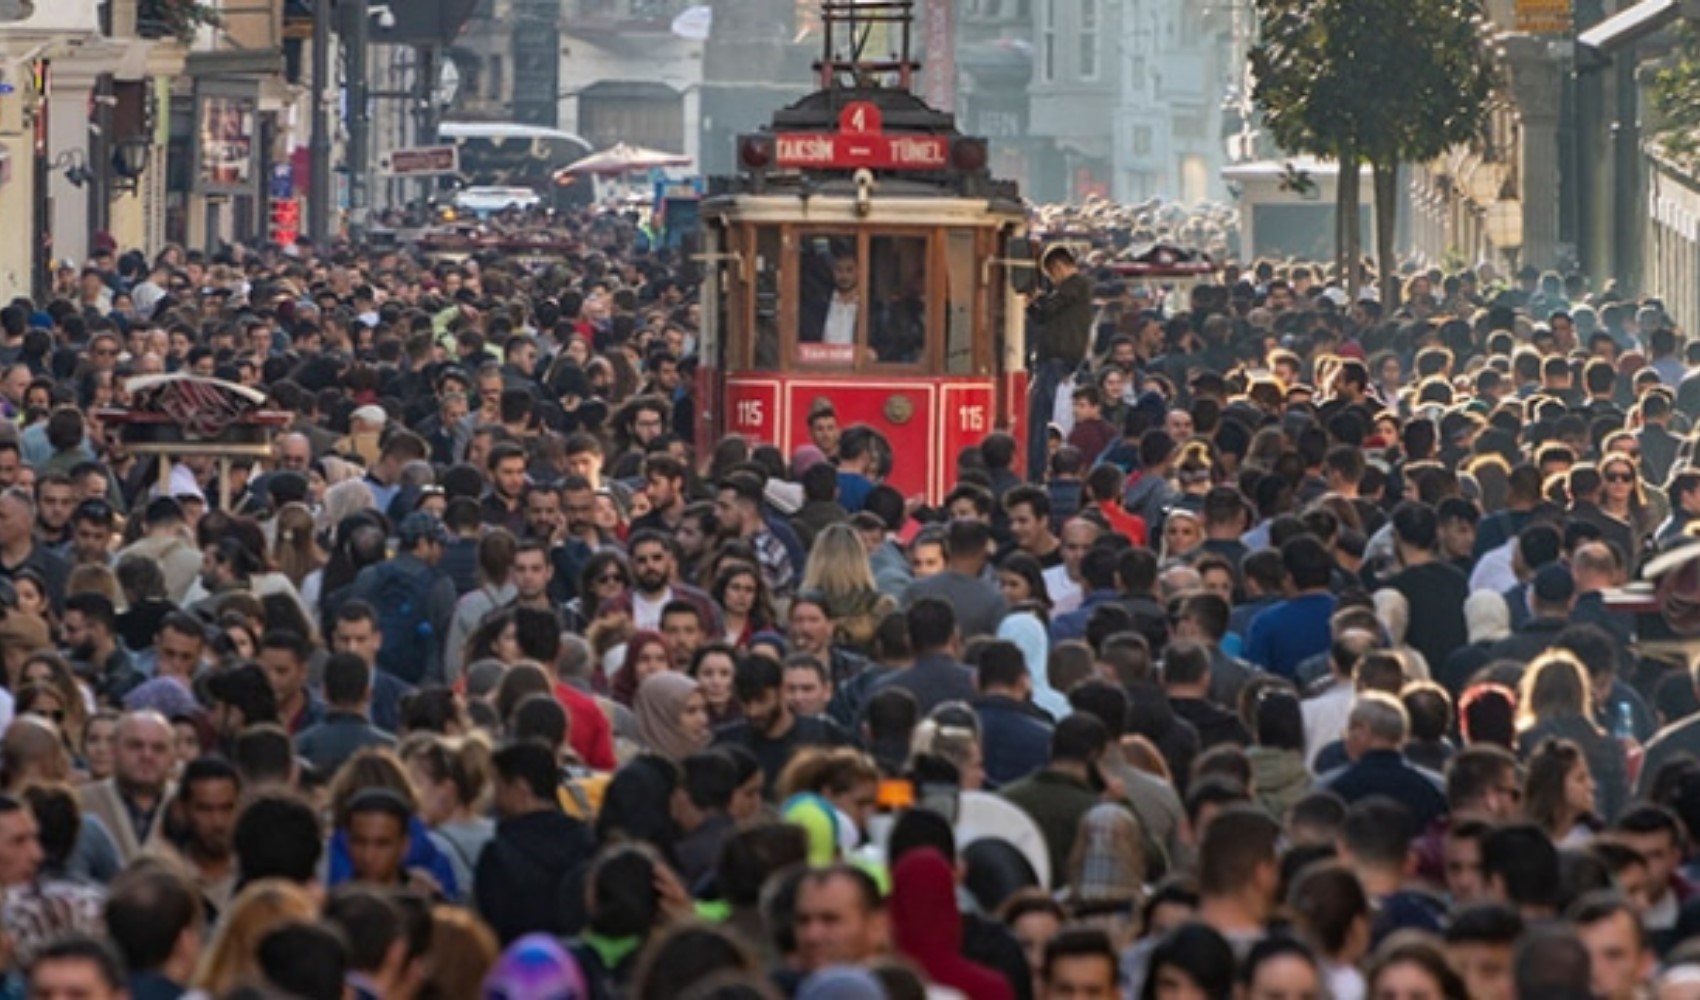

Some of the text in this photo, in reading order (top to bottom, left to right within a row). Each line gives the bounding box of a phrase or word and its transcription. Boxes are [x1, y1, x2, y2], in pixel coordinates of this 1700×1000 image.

[852, 106, 865, 133] 4
[888, 137, 945, 163] TÜNEL
[736, 399, 764, 426] 115
[959, 404, 984, 432] 115
